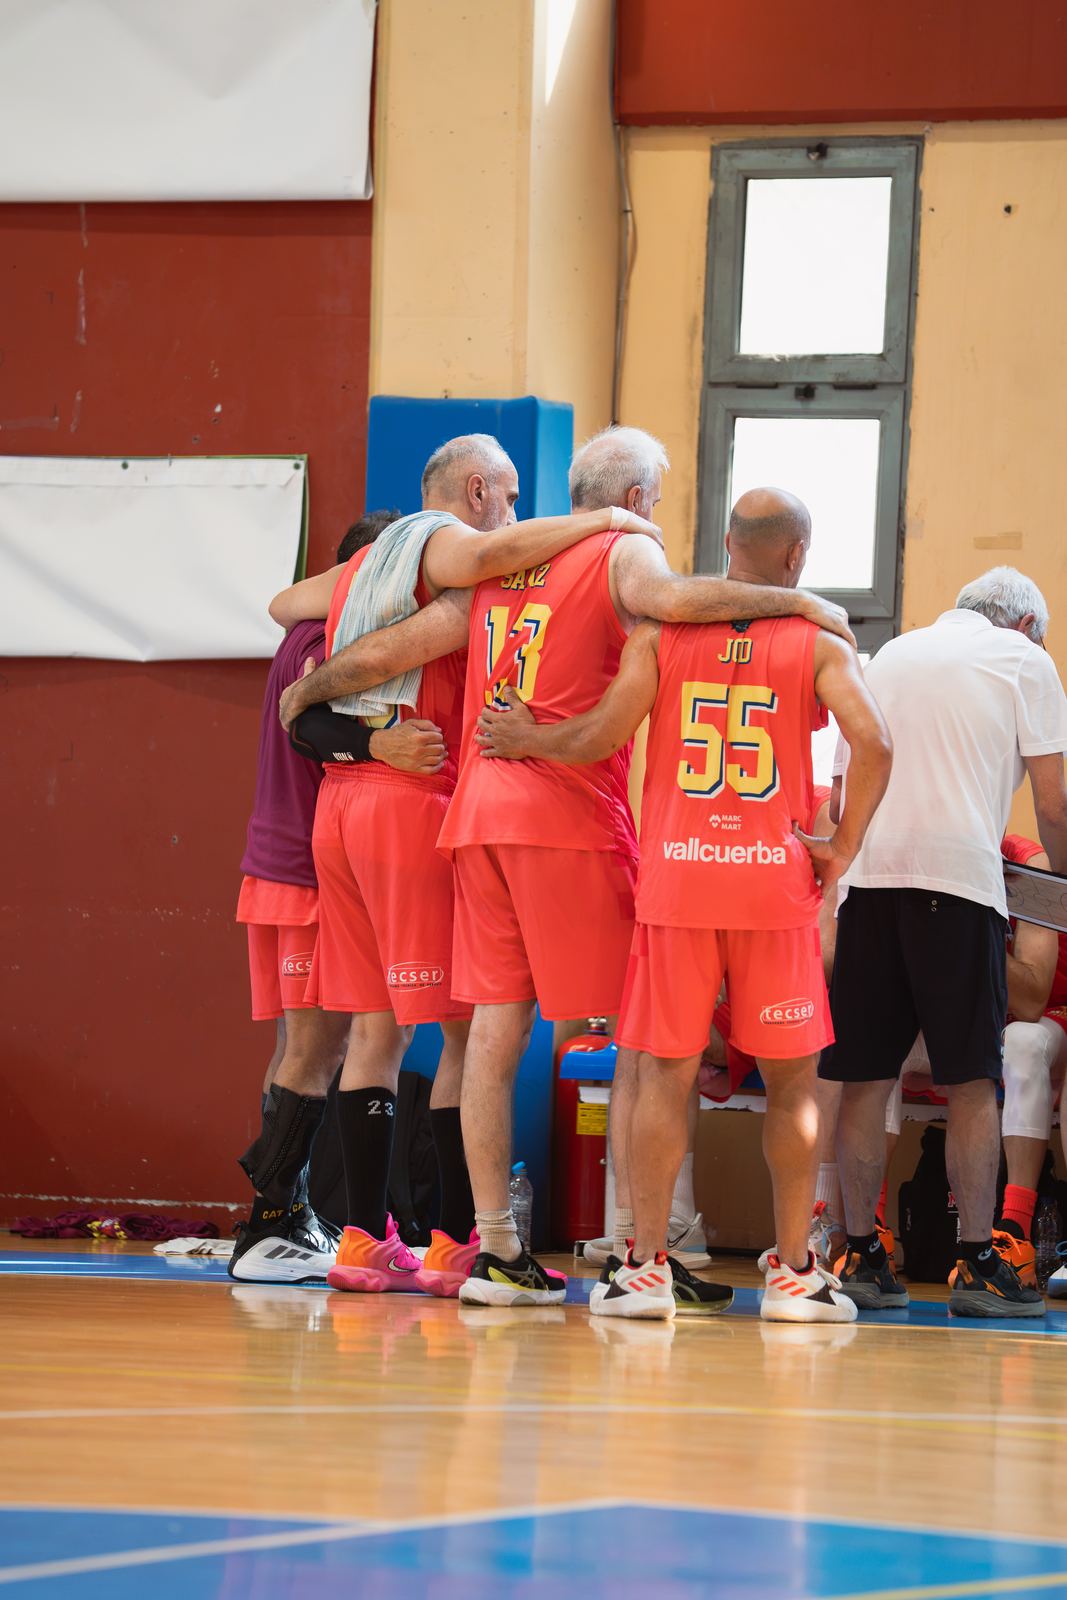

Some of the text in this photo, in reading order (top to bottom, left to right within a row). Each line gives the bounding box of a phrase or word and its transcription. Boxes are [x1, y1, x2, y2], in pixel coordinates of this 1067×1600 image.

[484, 602, 552, 711] 13
[677, 681, 780, 802] 55
[721, 814, 742, 822] MARC
[721, 823, 742, 831] MART
[663, 837, 787, 865] vallcuerba
[764, 1005, 813, 1020] tecser
[367, 1099, 394, 1117] 23
[262, 1209, 285, 1220] CAT
